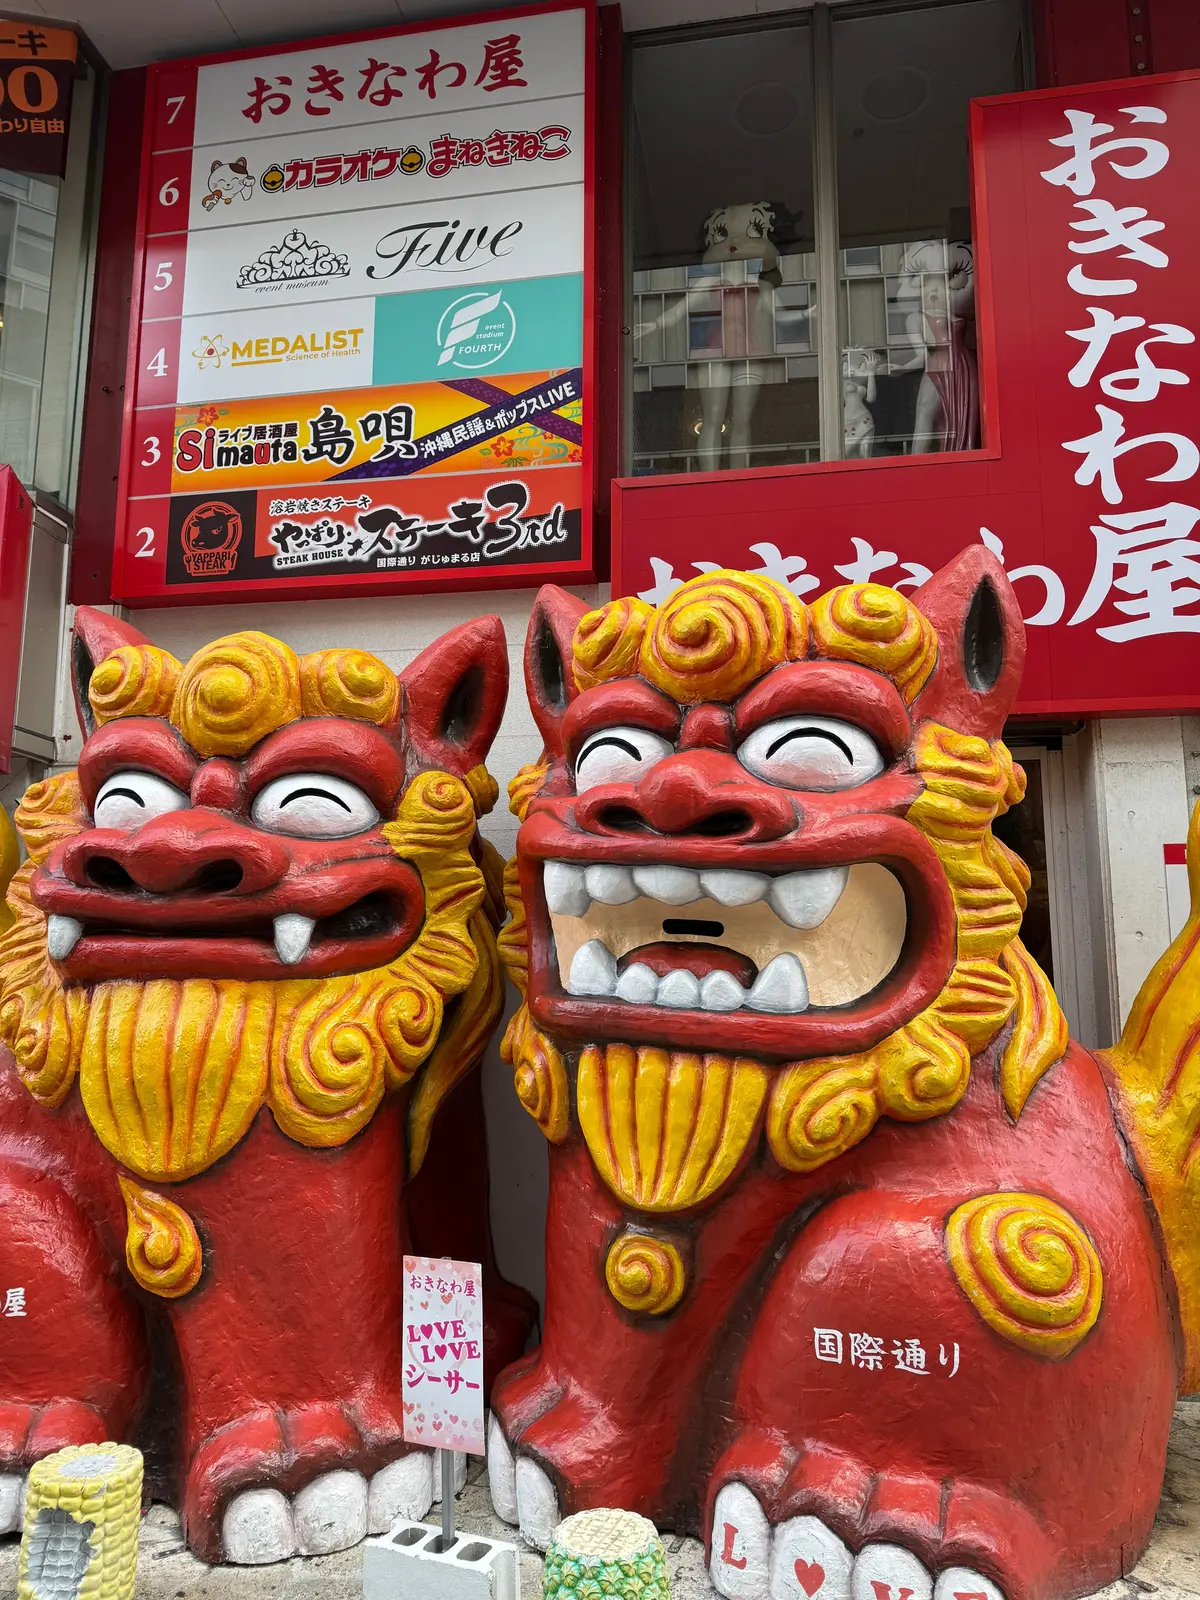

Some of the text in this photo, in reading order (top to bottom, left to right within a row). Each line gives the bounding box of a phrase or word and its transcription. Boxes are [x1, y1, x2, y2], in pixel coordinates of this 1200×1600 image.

[0, 65, 59, 113] 0
[241, 33, 529, 124] おきなわ屋
[165, 95, 186, 124] 7
[283, 124, 572, 192] カラオケ まねきねこ
[158, 177, 180, 206] 6
[365, 219, 524, 280] Five
[152, 262, 174, 292] 5
[255, 279, 330, 294] event museum
[475, 331, 504, 340] stadium
[485, 322, 505, 331] event
[231, 328, 364, 359] MEDALIST
[285, 347, 361, 362] Science of Health
[458, 343, 502, 355] FOURTH
[146, 348, 169, 378] 4
[1040, 106, 1200, 643] おきなわ屋
[218, 422, 299, 444] ライブ居酒屋
[301, 405, 418, 465] 島唄
[141, 436, 163, 467] 3
[176, 428, 298, 472] Simauta
[270, 494, 372, 515] 溶岩焼きステーキ
[135, 527, 156, 558] 2
[191, 551, 231, 562] YAPPARI
[193, 559, 227, 571] STEAK
[276, 549, 344, 566] STEAK HOUSE
[376, 552, 481, 569] 国際通り がじゅまる店
[409, 1275, 477, 1297] おきなわ屋
[813, 1326, 961, 1378] 国際通り
[404, 1364, 480, 1395] シーサー
